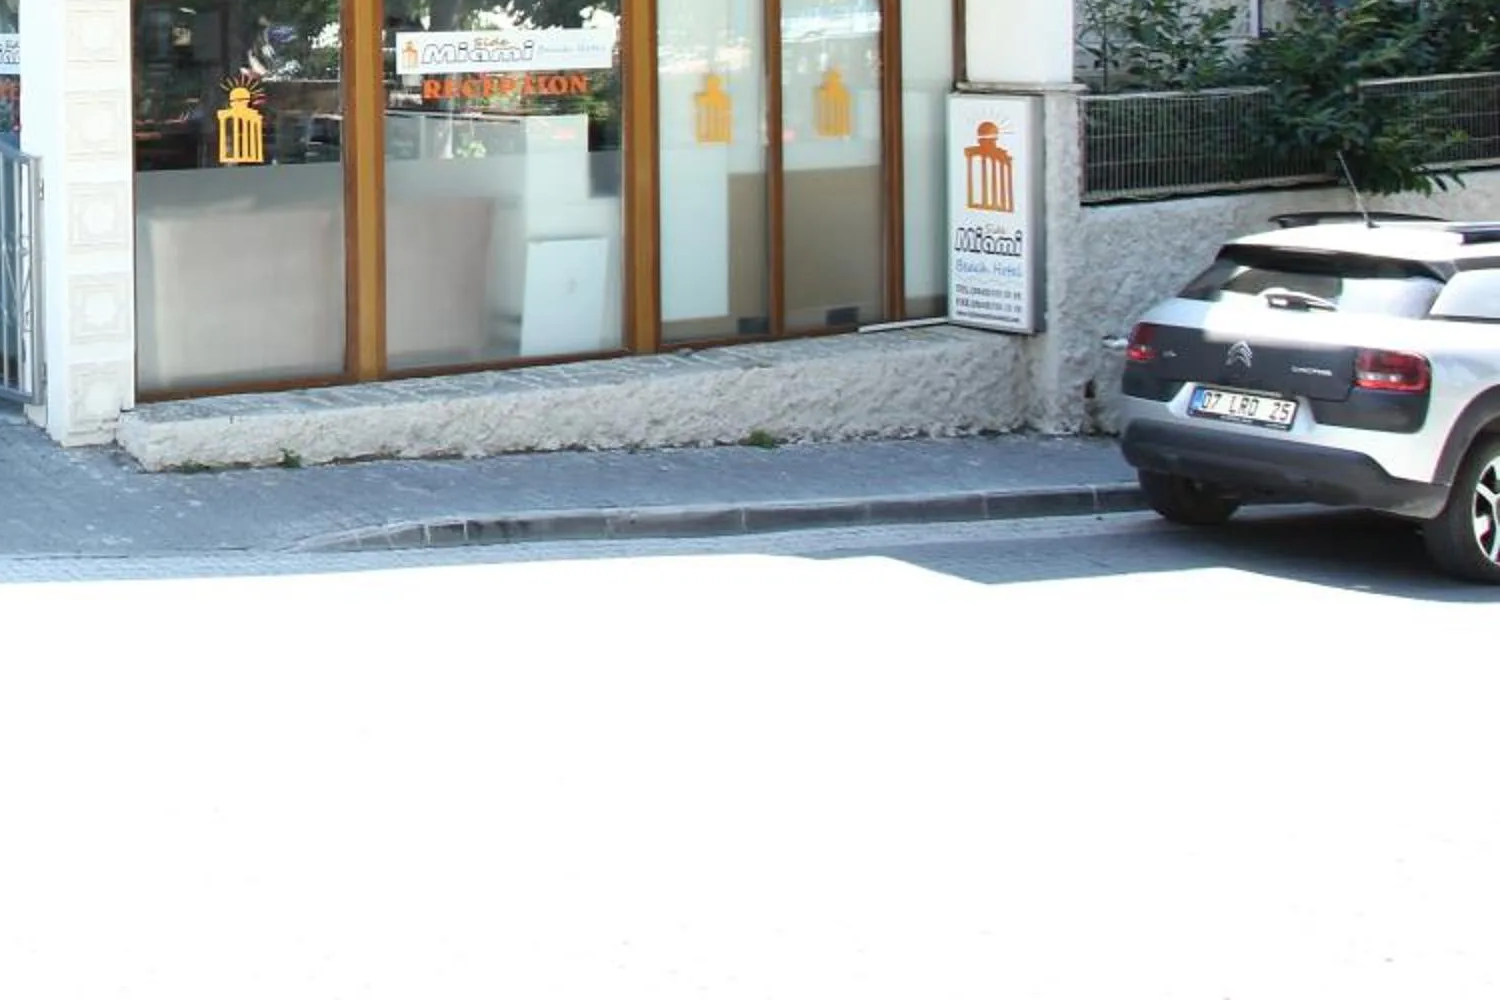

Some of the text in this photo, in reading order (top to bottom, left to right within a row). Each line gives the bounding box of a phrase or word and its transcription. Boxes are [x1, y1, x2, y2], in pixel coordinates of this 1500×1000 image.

[420, 39, 535, 64] Miami
[955, 226, 1023, 257] Miami
[1269, 401, 1292, 421] 25
